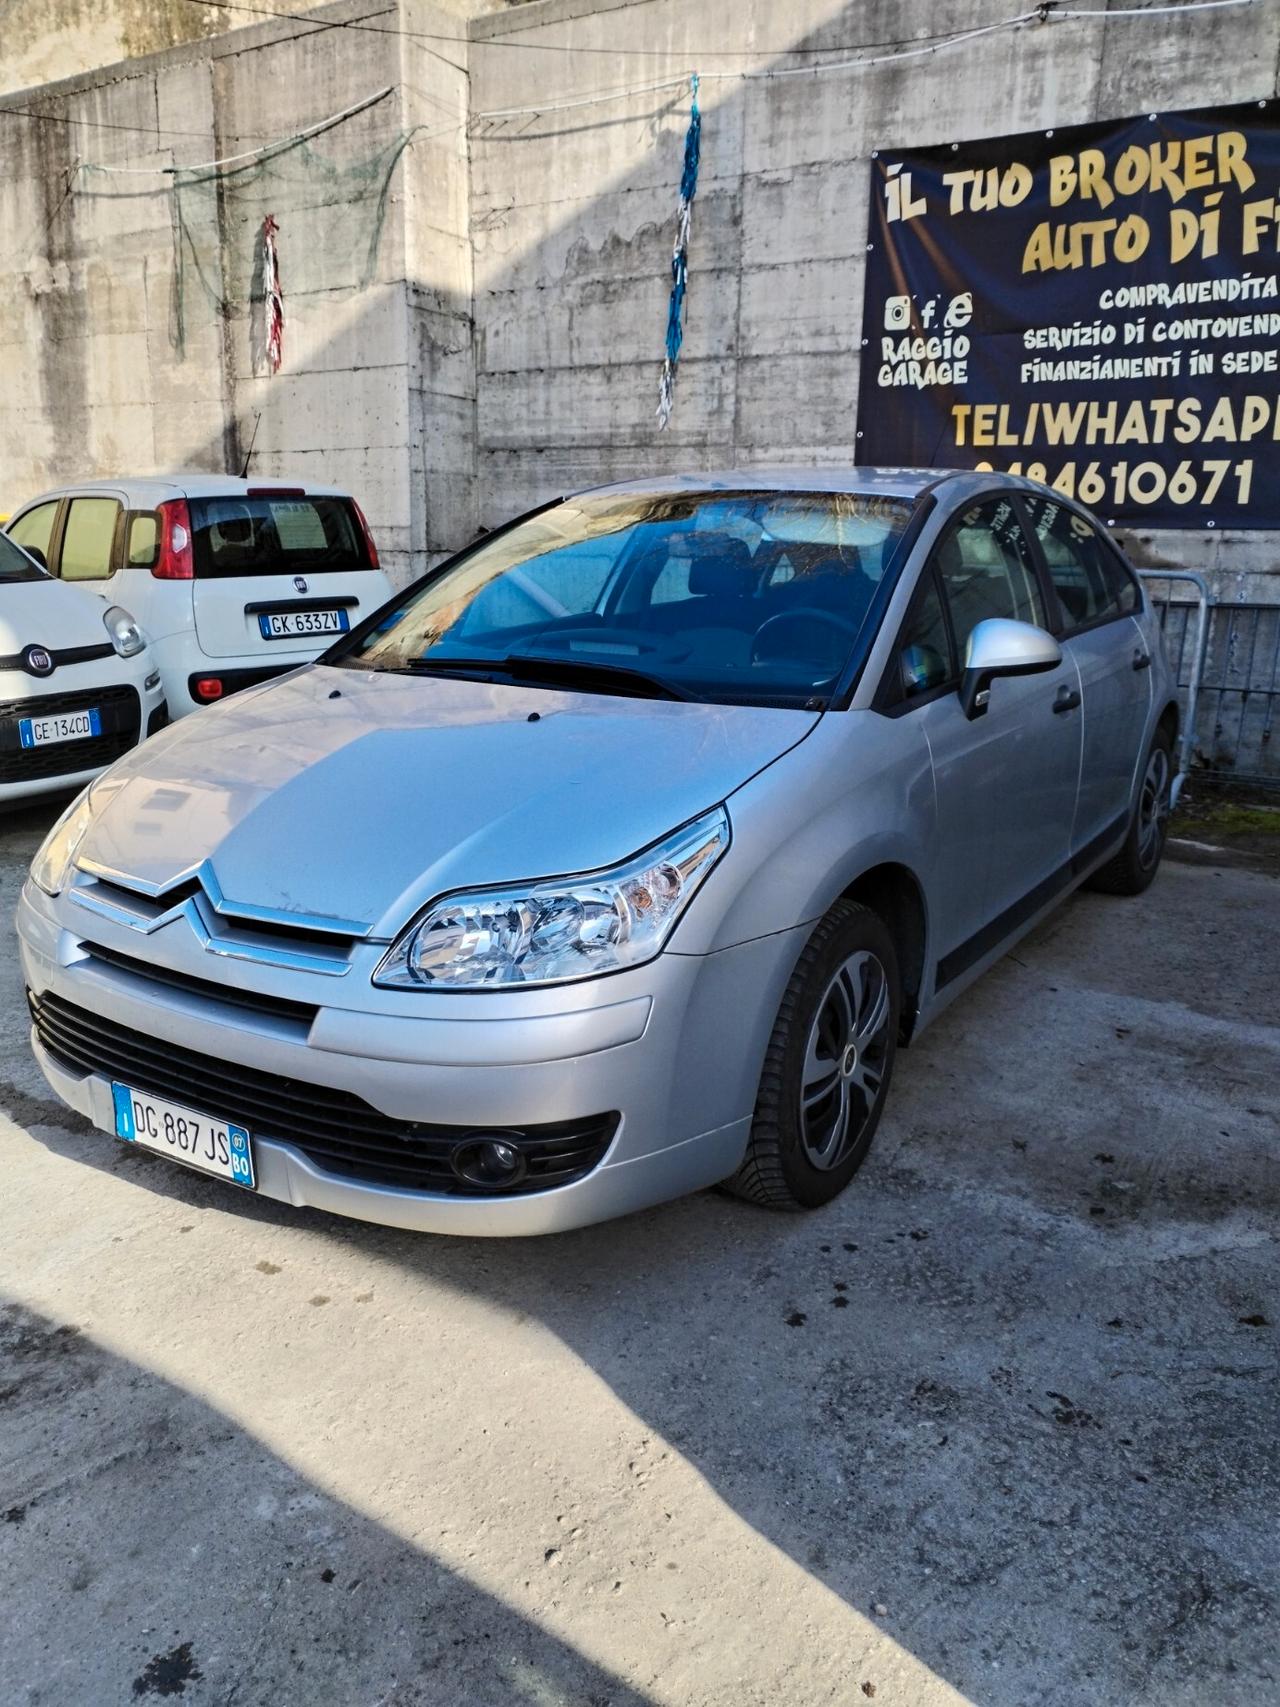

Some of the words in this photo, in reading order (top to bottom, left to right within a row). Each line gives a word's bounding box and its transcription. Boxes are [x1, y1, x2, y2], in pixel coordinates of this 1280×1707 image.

[943, 162, 1033, 215] TUO
[1050, 131, 1255, 210] BROKER
[1022, 214, 1150, 274] AUTO
[877, 360, 968, 390] GARAGE
[1221, 350, 1278, 374] SEDE
[271, 616, 291, 634] GK
[295, 612, 338, 632] 633ZV
[34, 723, 50, 741] GE
[54, 716, 90, 737] 134CD
[133, 1101, 158, 1138] DG
[232, 1153, 249, 1176] BO
